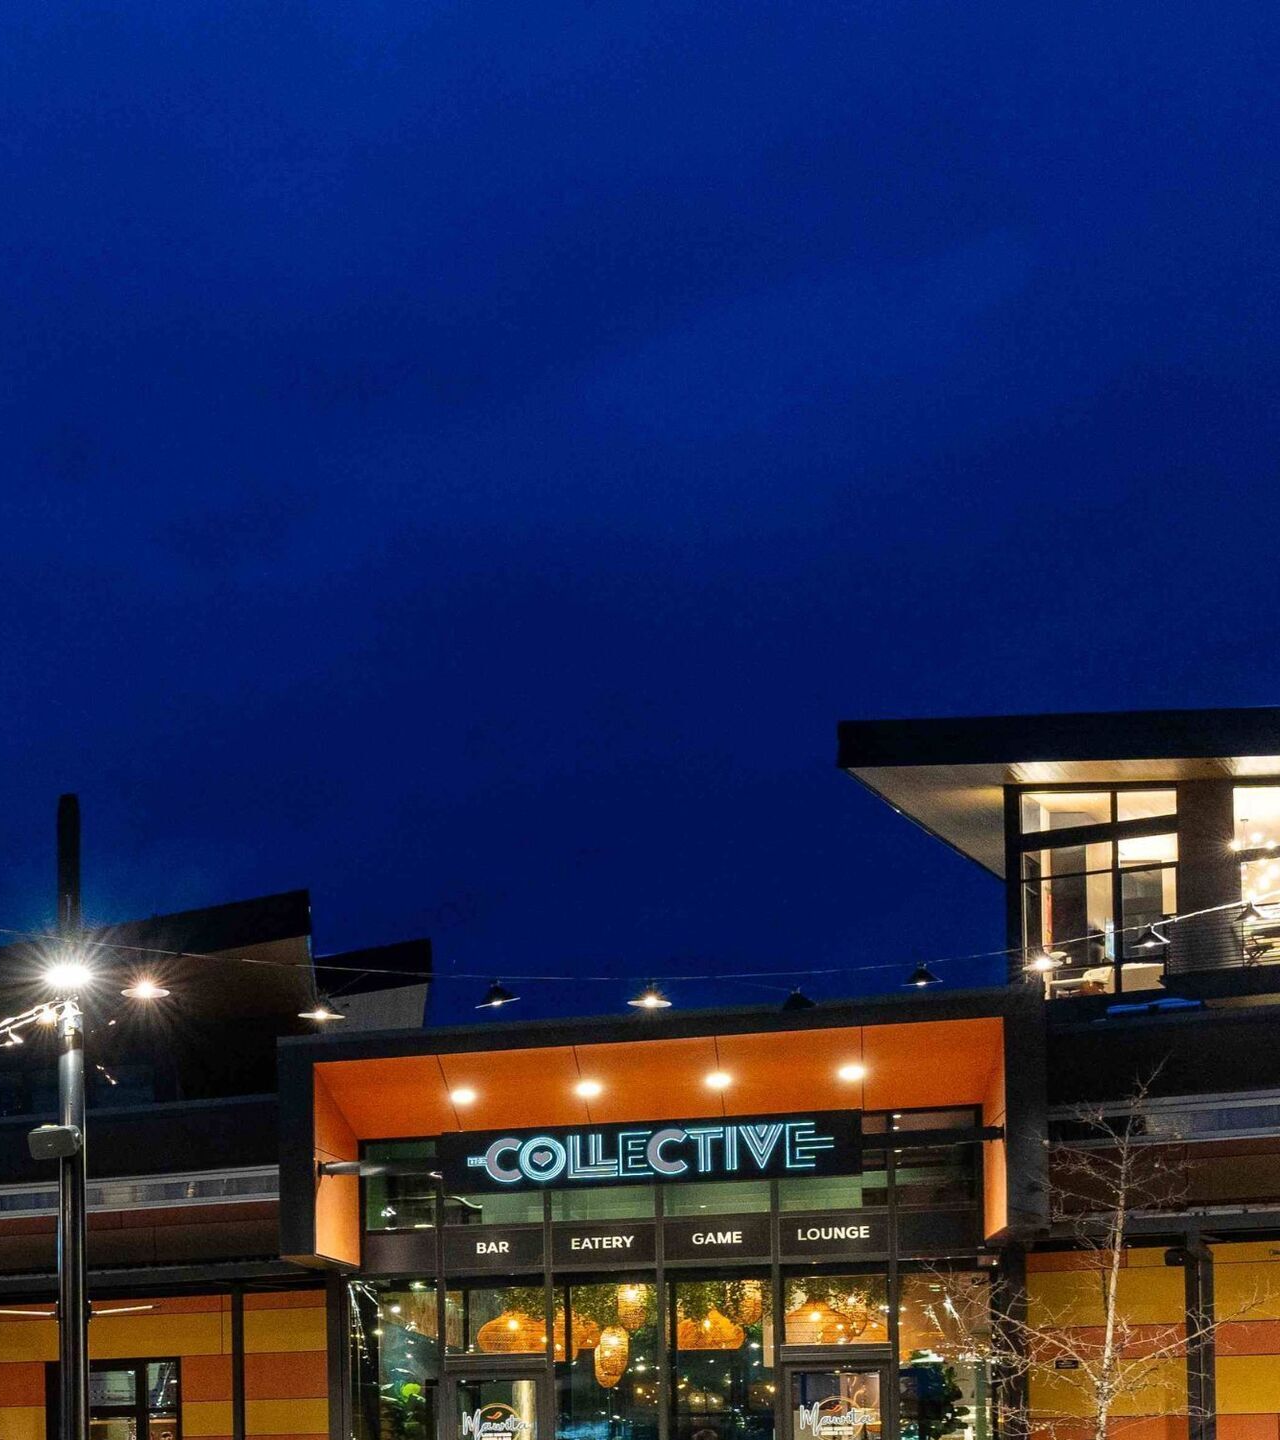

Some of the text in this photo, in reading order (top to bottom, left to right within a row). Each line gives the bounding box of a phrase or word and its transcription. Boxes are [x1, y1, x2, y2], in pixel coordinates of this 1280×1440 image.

[485, 1122, 835, 1183] COLLECTIVE
[692, 1231, 743, 1246] GAME
[797, 1225, 871, 1241] LOUNGE
[476, 1241, 510, 1255] BAR
[570, 1235, 635, 1251] EATERY
